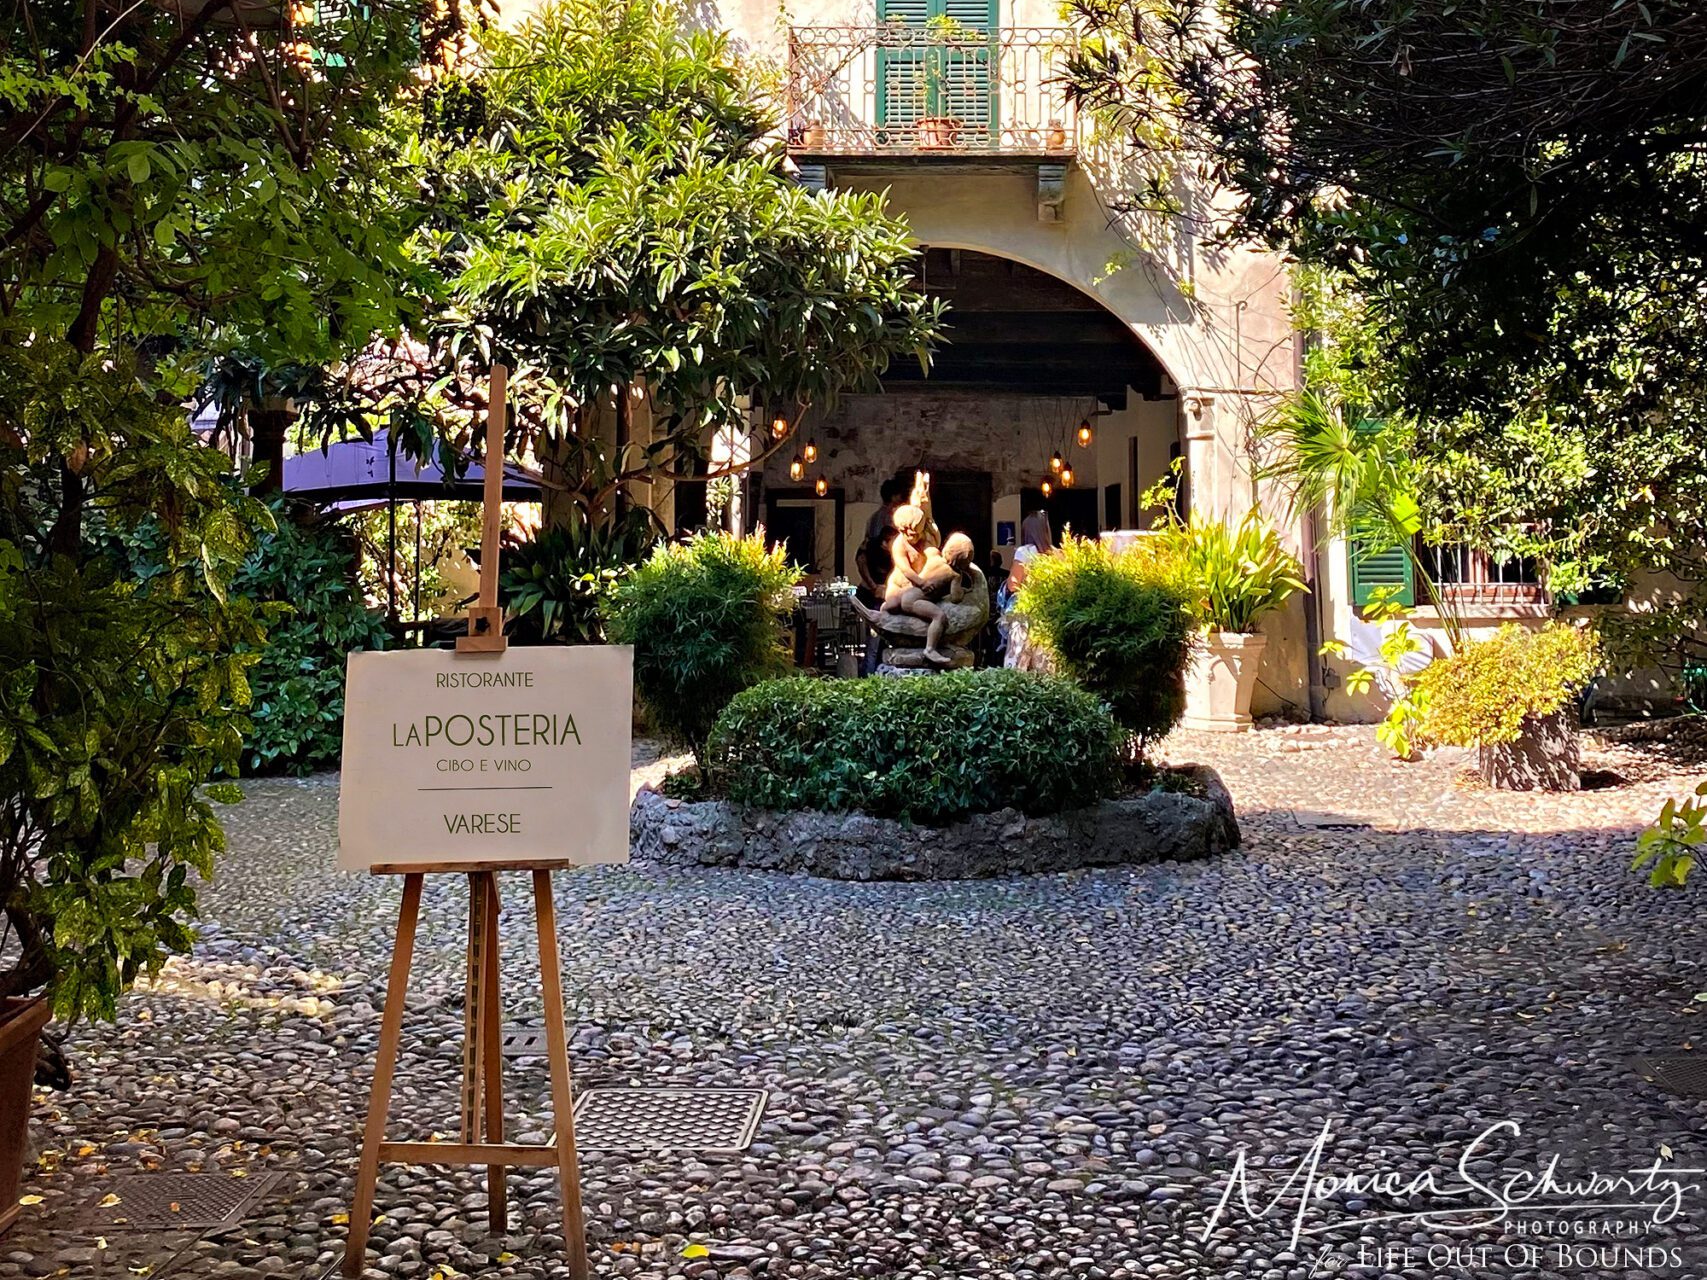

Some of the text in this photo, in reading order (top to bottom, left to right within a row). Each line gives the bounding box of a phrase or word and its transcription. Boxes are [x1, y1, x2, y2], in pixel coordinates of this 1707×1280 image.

[436, 672, 534, 688] RISTORANTE
[436, 759, 532, 772] CIBO E VINO
[443, 813, 521, 834] VARESE
